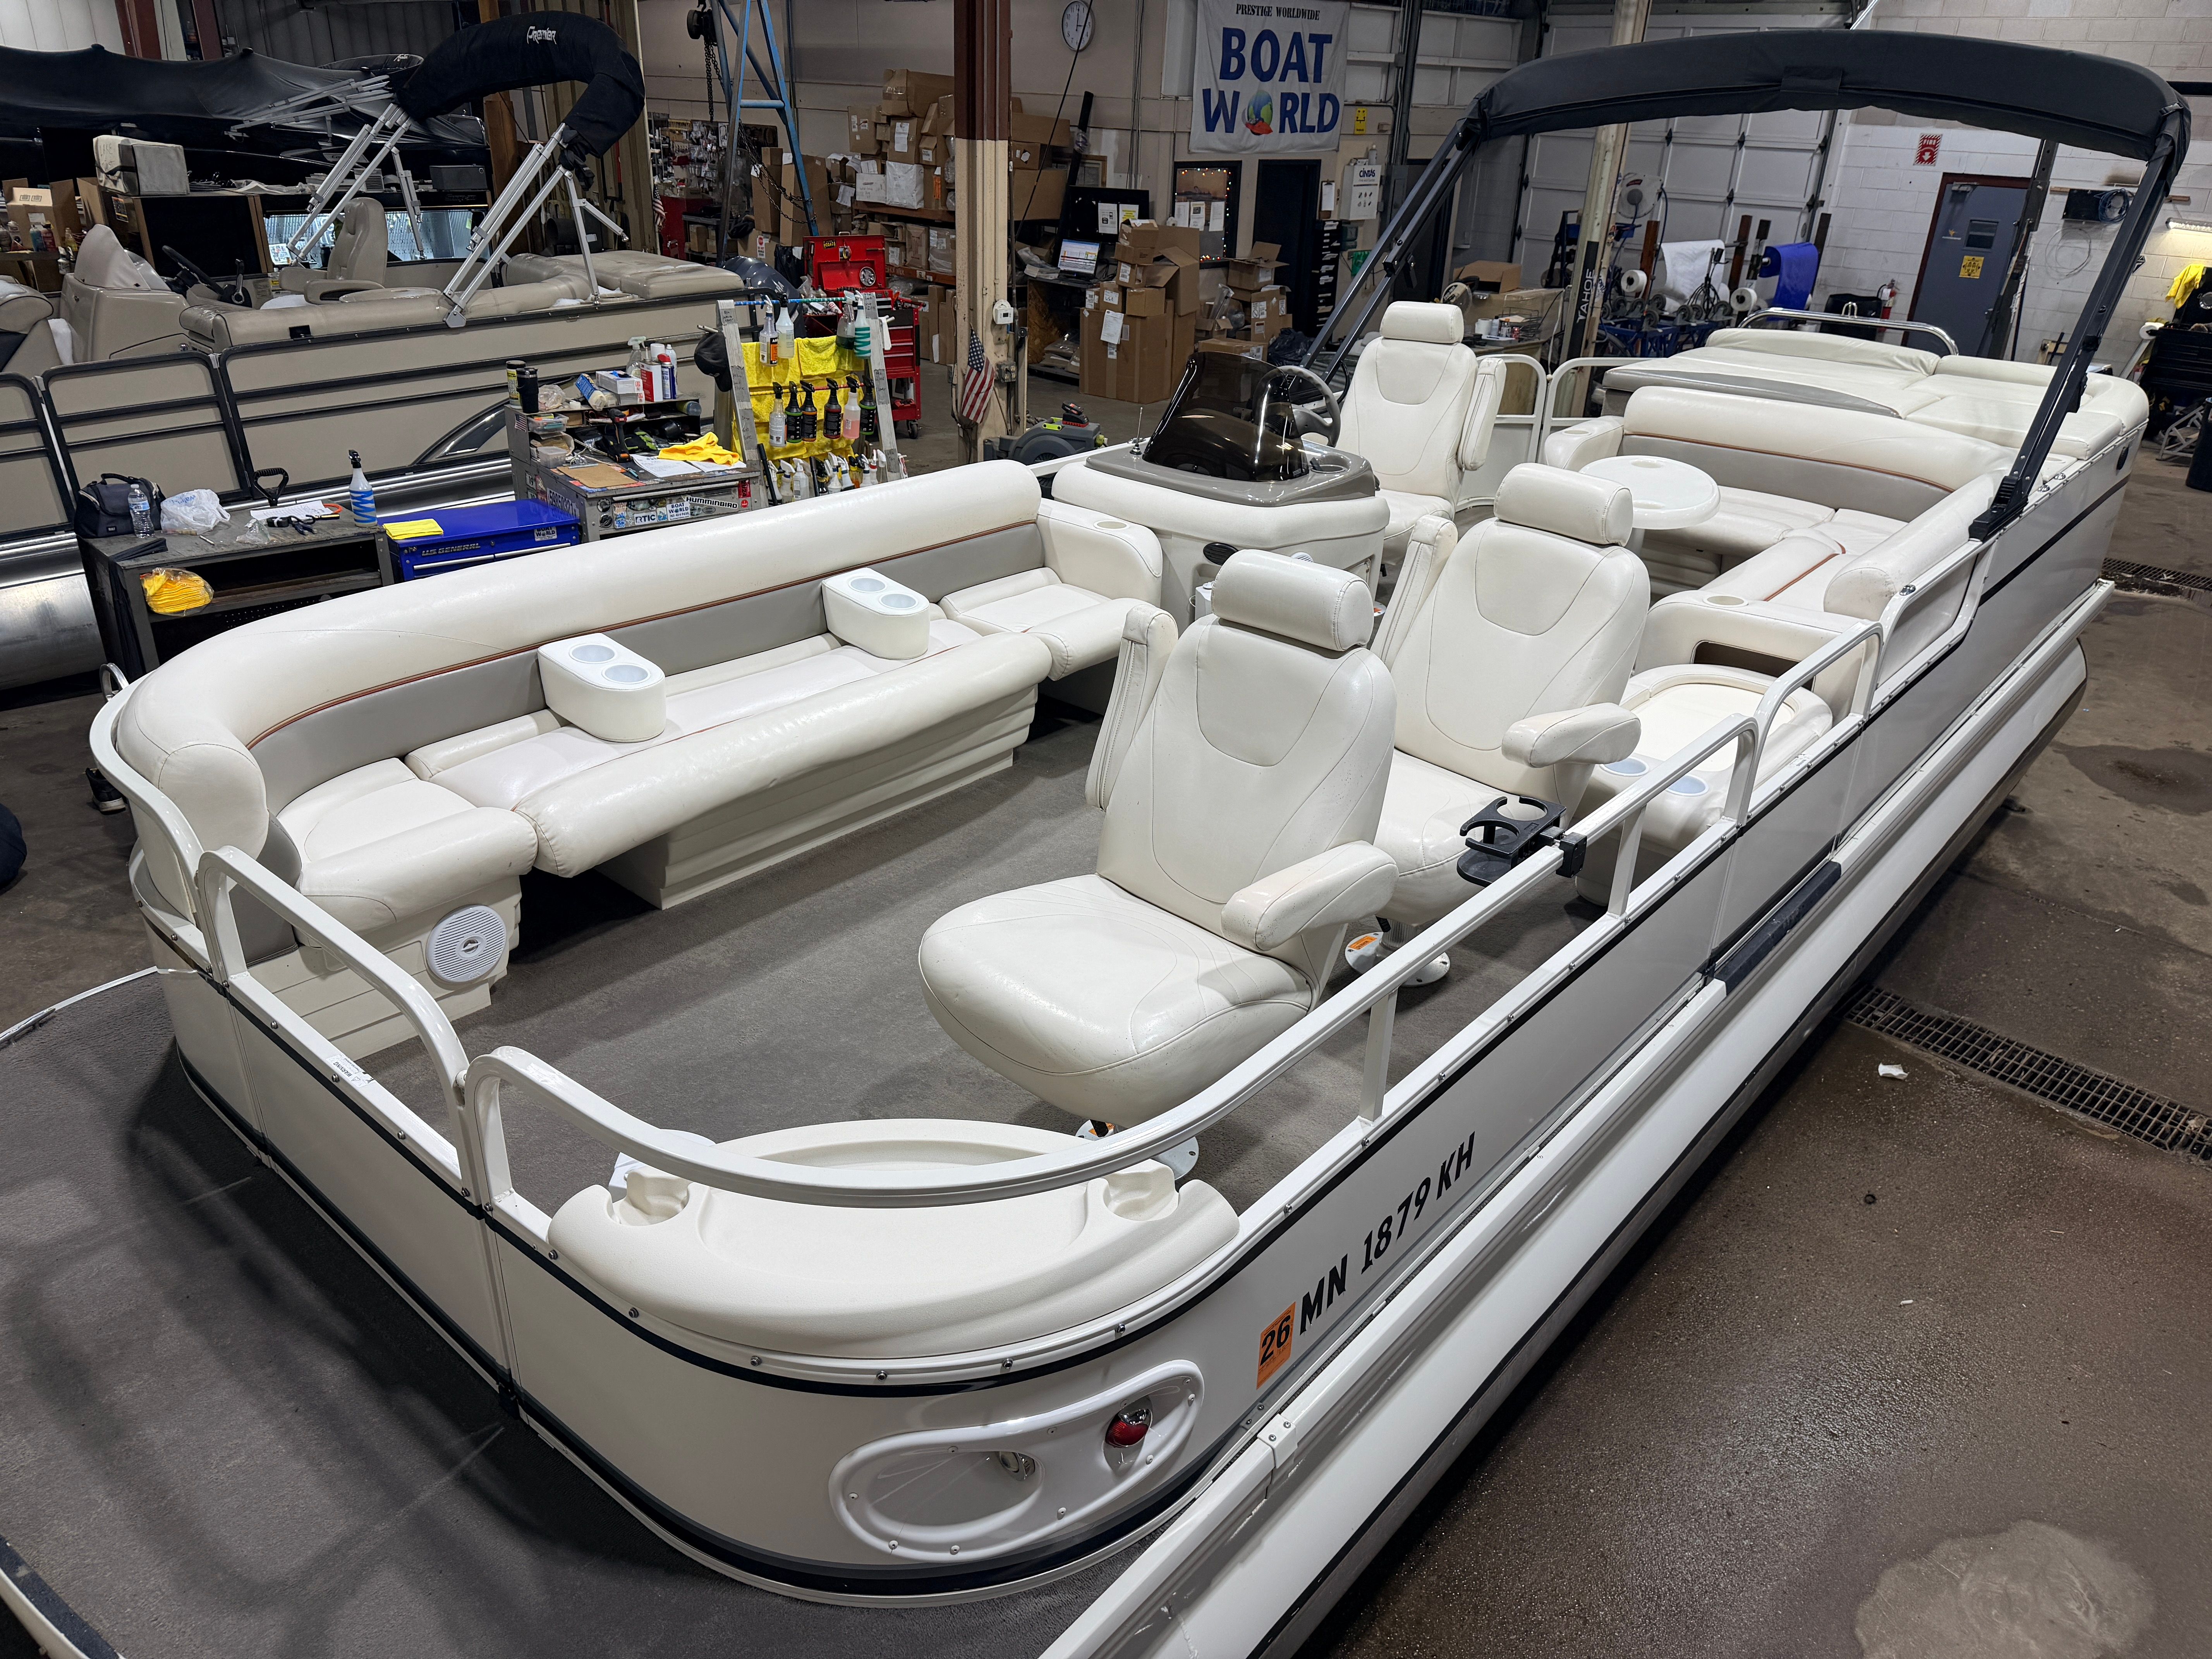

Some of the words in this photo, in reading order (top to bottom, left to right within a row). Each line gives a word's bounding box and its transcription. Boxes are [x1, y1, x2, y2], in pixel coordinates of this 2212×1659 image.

[1236, 3, 1272, 17] PRESTIGE
[1276, 5, 1320, 21] WORLDWIDE
[1219, 27, 1333, 83] BOAT
[686, 497, 738, 508] HUMMINBIRD
[438, 543, 481, 554] GENERAL
[333, 1062, 352, 1077] WARNING
[1300, 1253, 1348, 1336] MN
[1361, 1177, 1431, 1274] 1879
[1437, 1131, 1475, 1200] KH
[1260, 1315, 1291, 1366] 26
